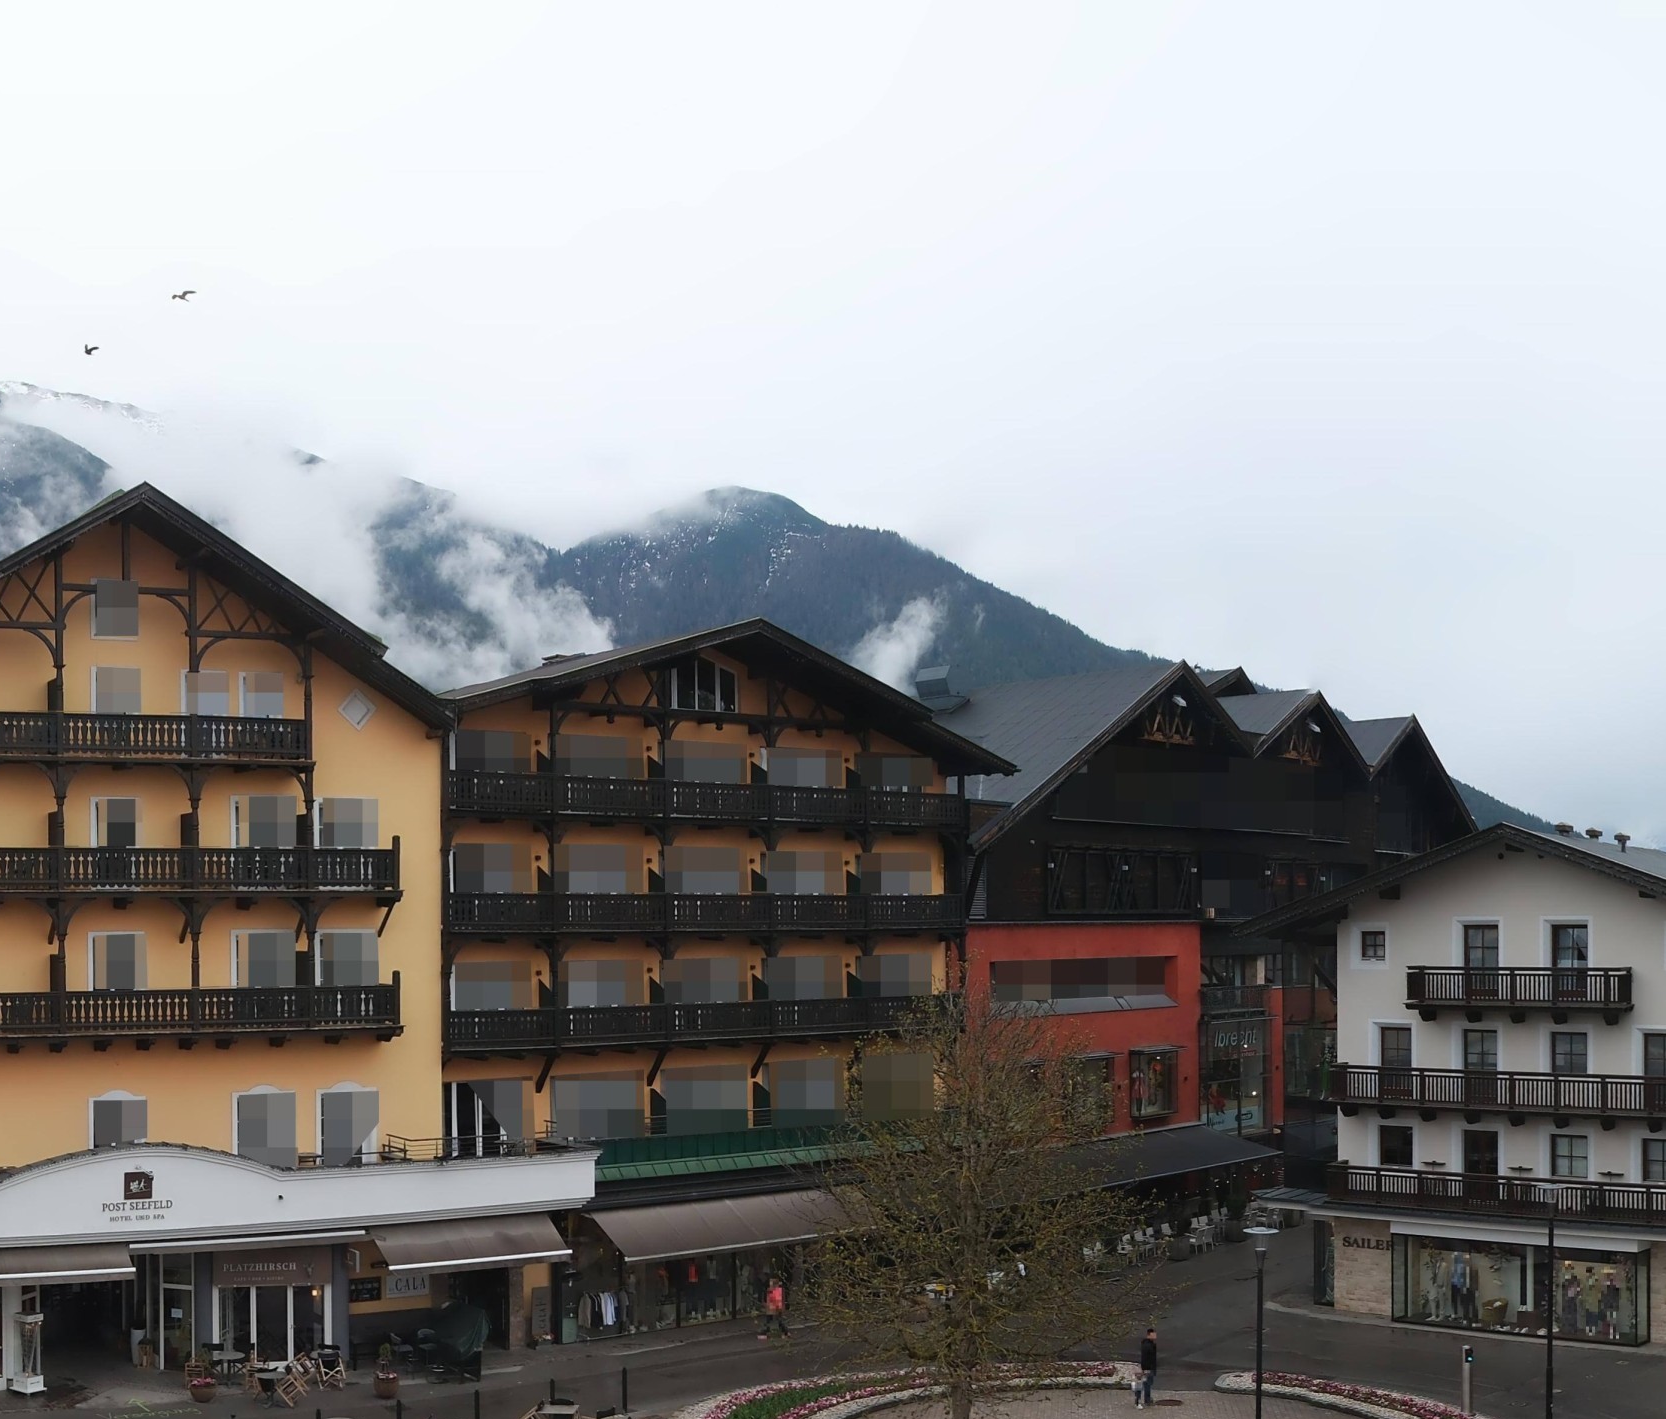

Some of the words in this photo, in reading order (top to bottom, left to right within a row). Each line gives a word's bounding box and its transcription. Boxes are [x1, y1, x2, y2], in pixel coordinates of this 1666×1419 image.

[102, 1202, 127, 1212] POST
[129, 1200, 173, 1211] SEEFELD
[223, 1262, 297, 1272] PLATZHIRSCH
[395, 1276, 427, 1292] CALA
